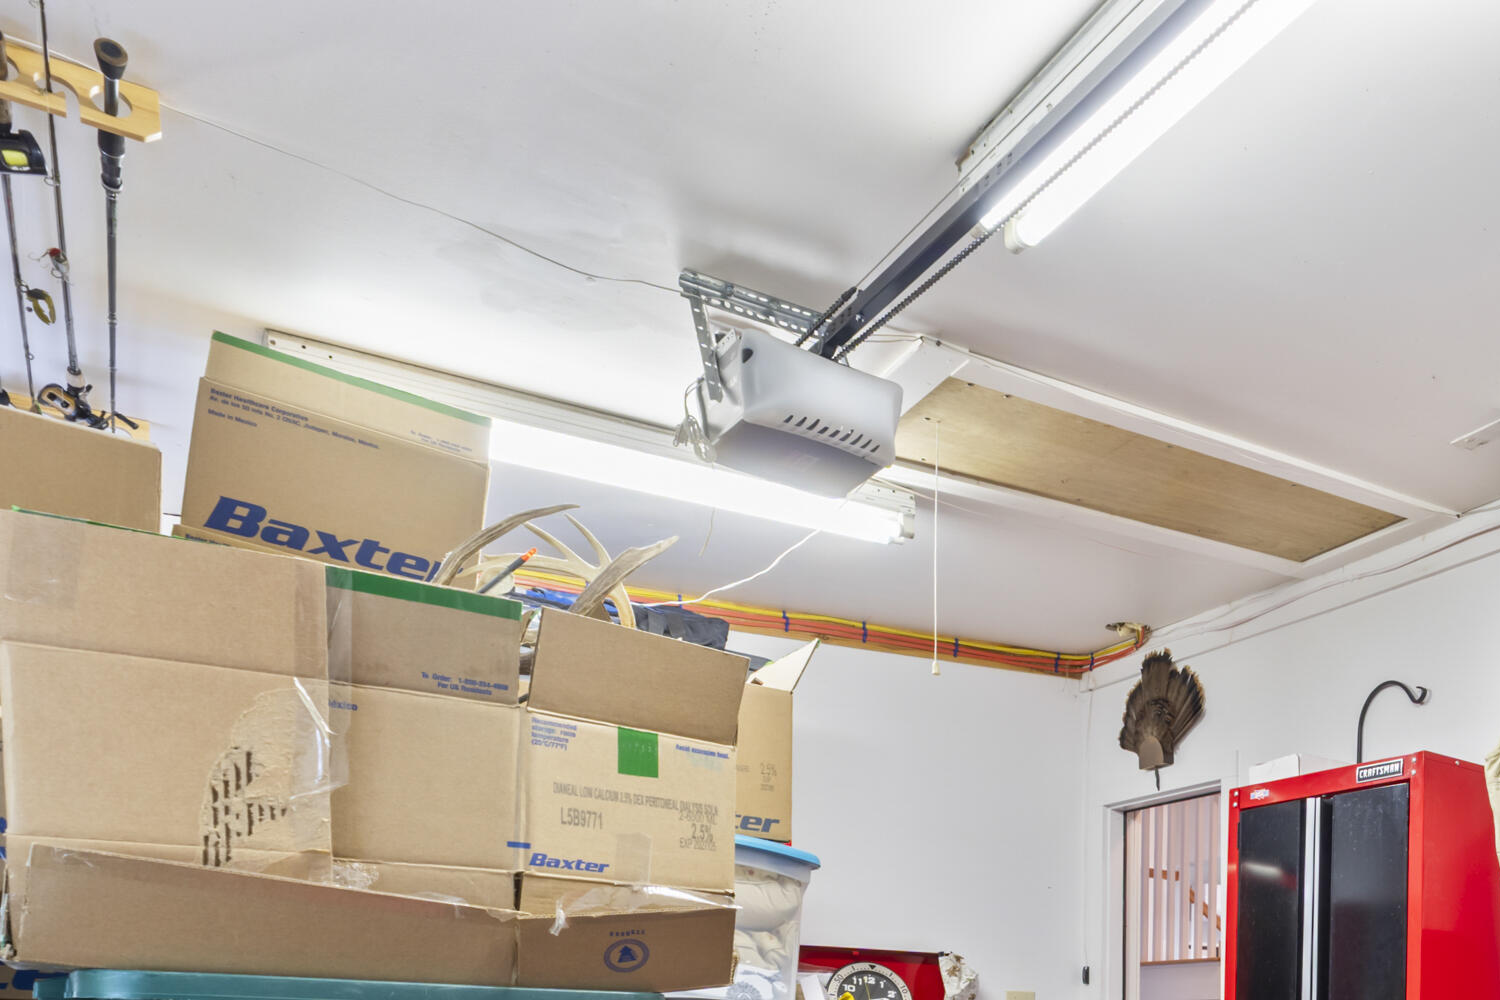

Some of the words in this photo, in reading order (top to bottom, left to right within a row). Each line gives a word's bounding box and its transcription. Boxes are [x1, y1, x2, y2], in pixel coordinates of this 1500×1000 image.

[1359, 762, 1400, 779] CRAFTSMAN
[559, 806, 604, 830] L5B9771
[690, 822, 714, 843] 2.5%
[529, 852, 610, 874] Baxter
[842, 983, 856, 993] 10
[852, 976, 863, 986] 11
[863, 975, 876, 985] 12
